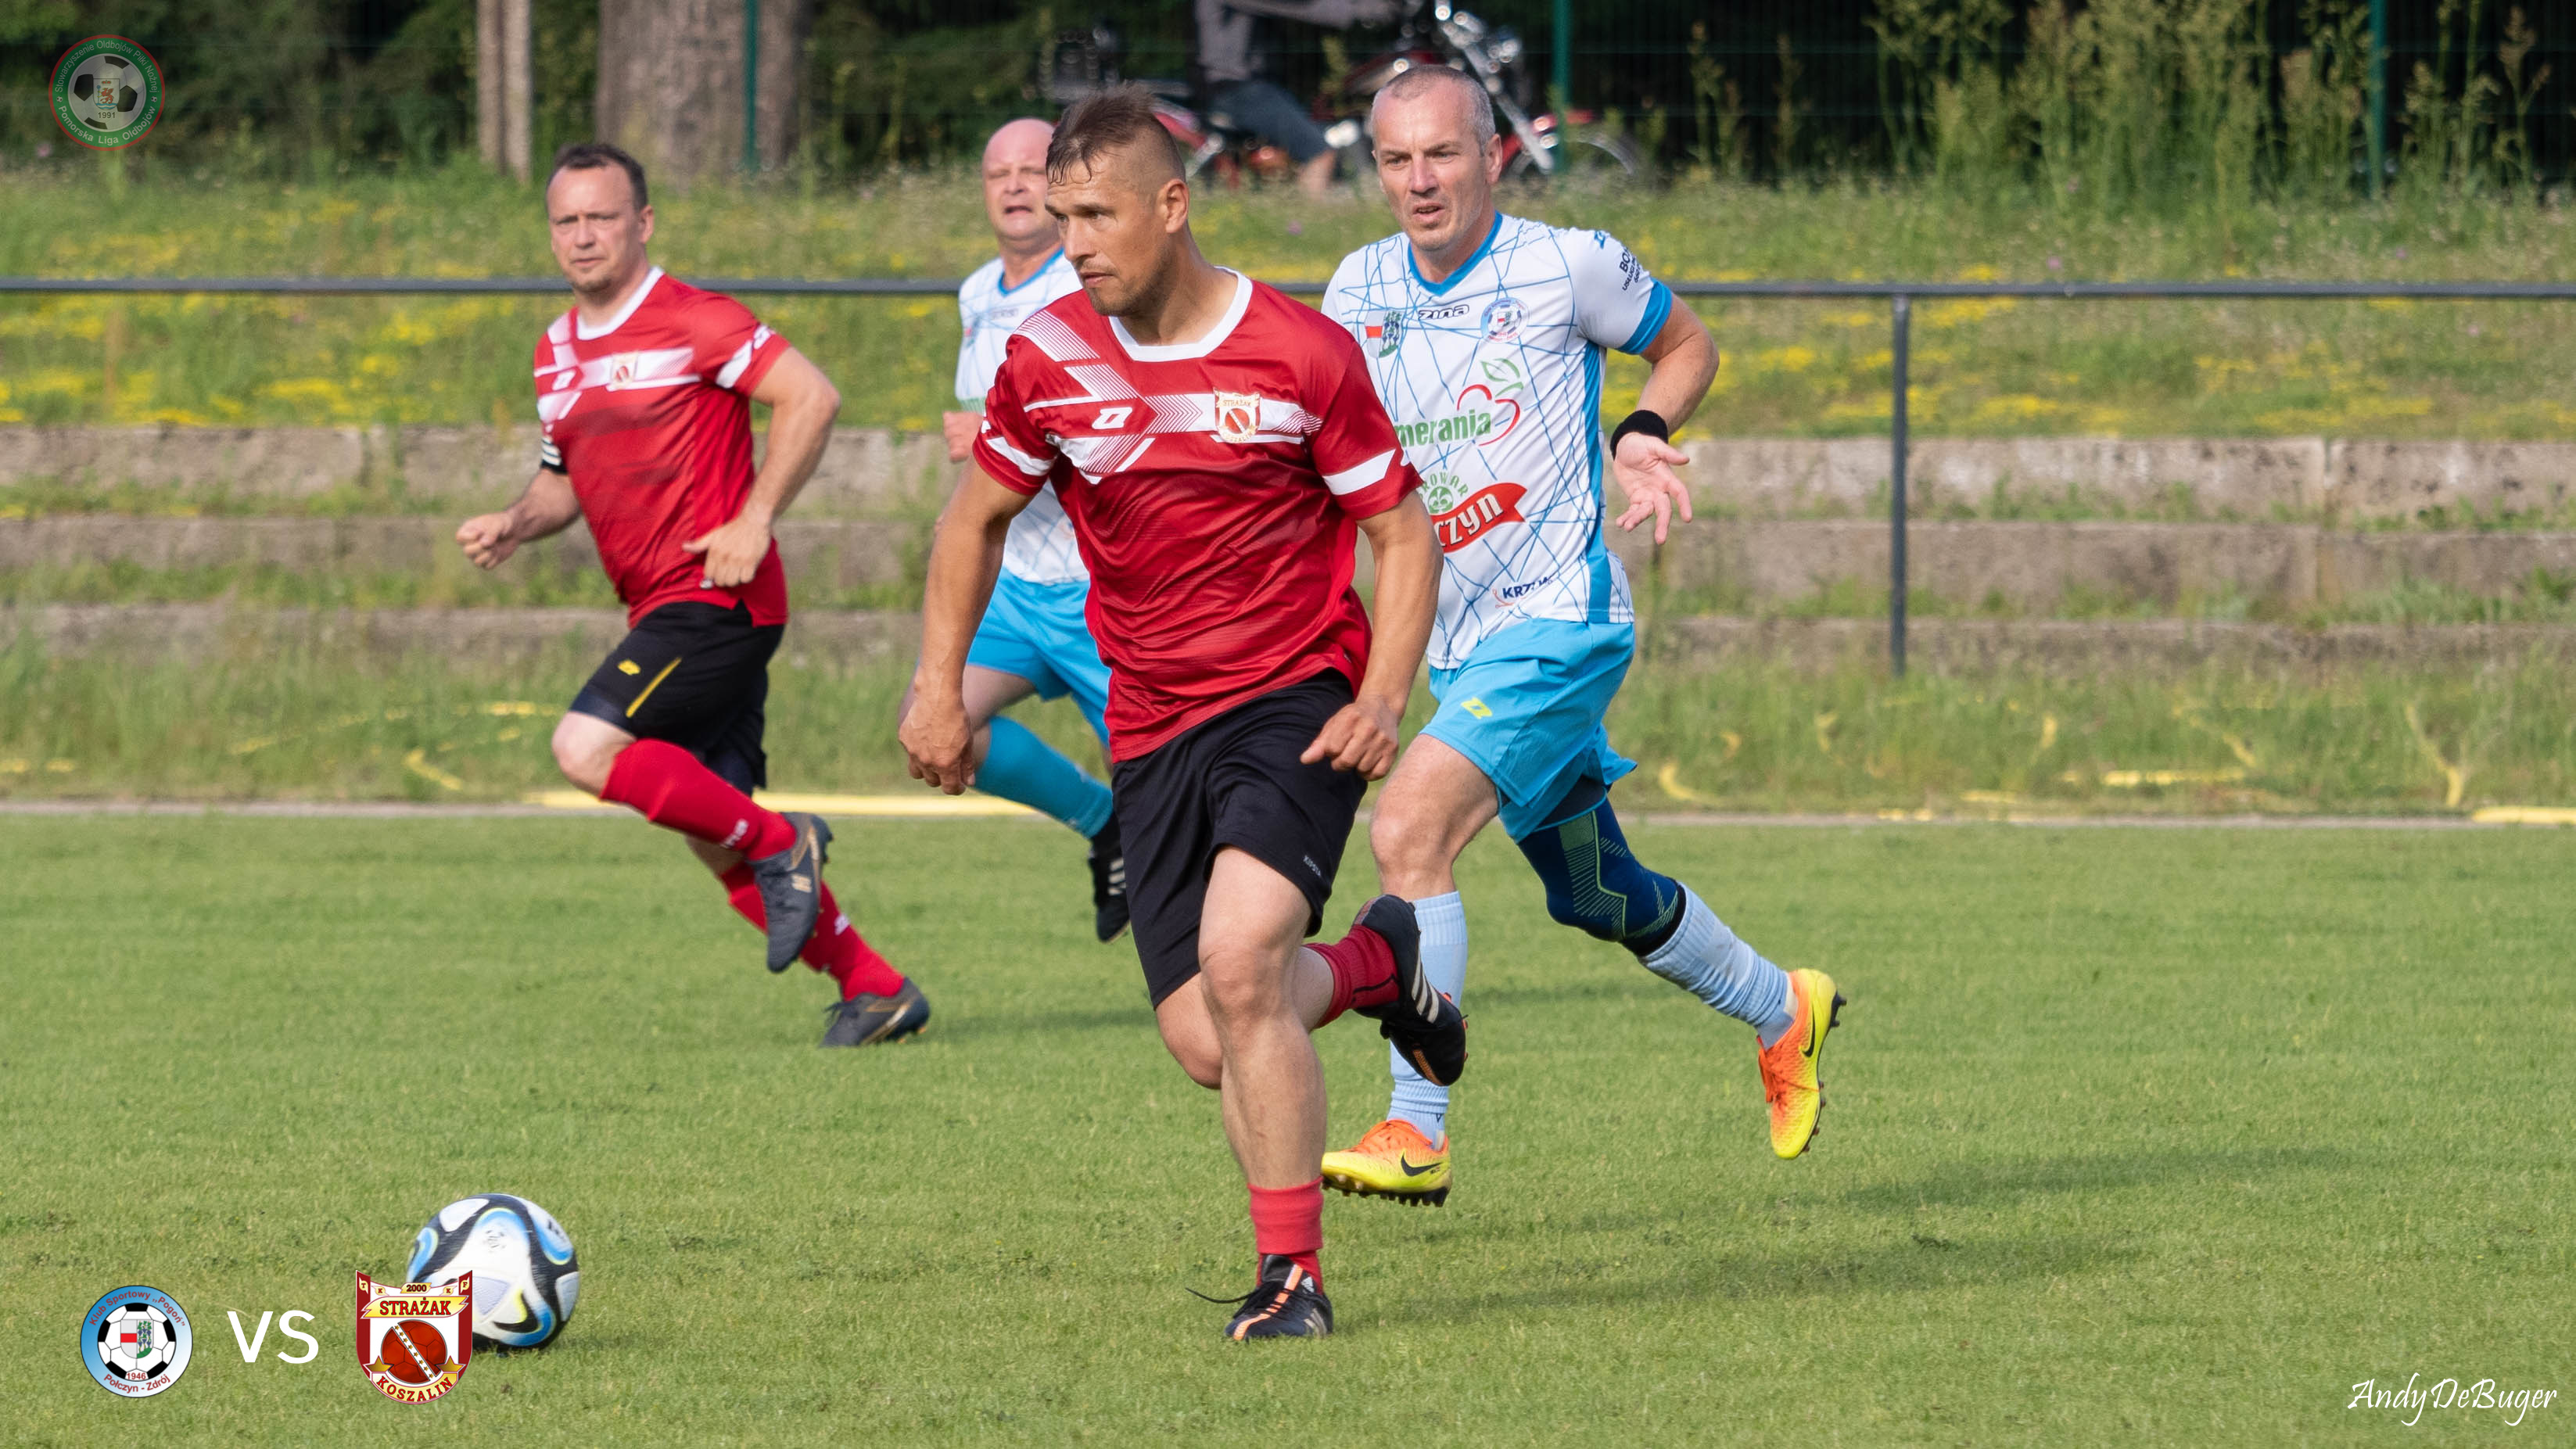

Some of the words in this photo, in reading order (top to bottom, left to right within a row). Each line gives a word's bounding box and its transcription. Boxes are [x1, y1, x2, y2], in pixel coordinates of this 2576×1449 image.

[1394, 409, 1491, 448] merania
[1420, 472, 1469, 498] ROWAR
[1433, 493, 1504, 547] czyn
